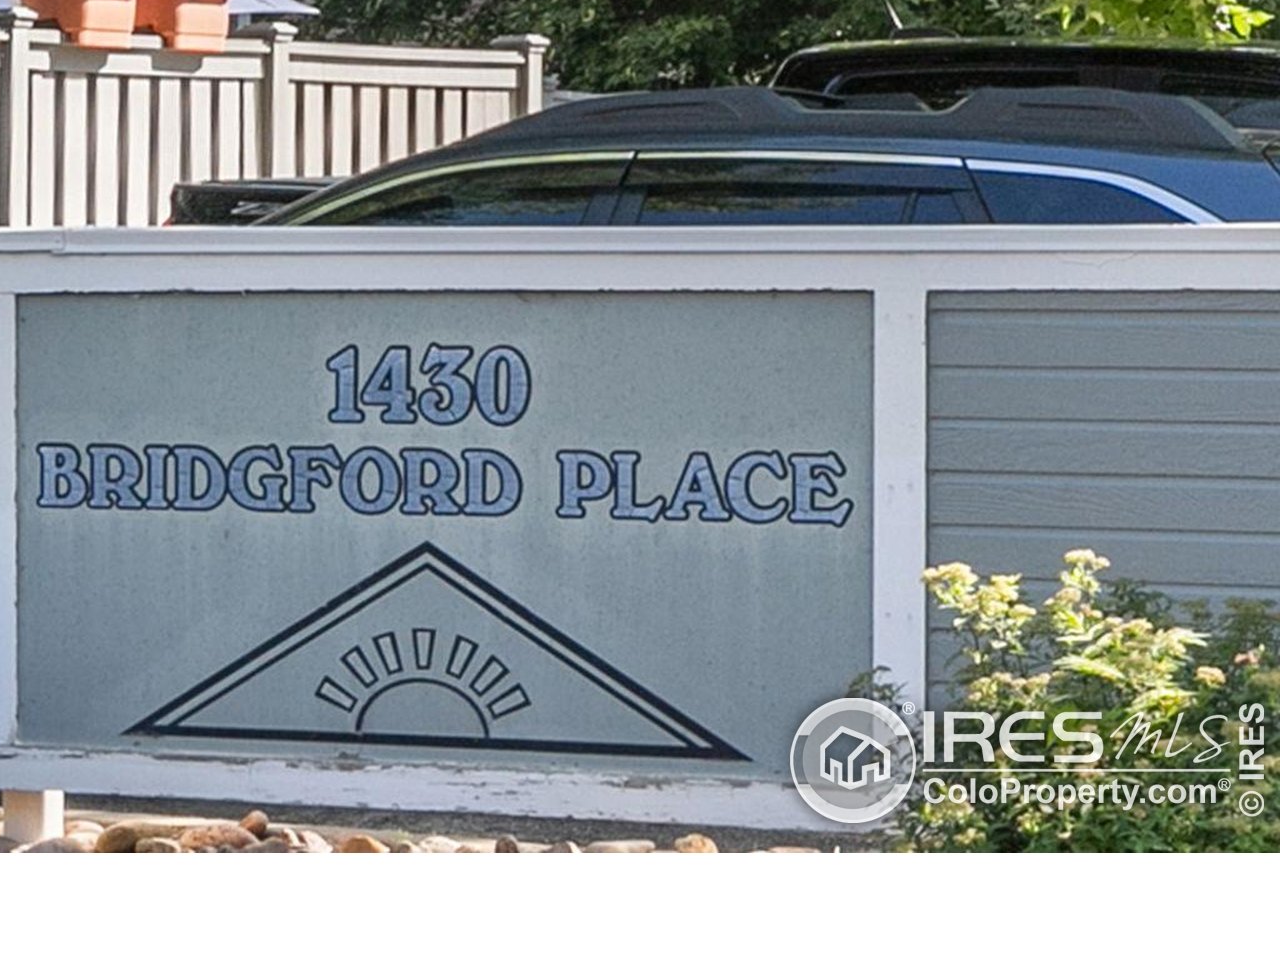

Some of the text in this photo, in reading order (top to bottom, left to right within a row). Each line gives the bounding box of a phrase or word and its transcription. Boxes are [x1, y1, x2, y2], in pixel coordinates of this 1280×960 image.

[326, 342, 532, 427] 1430
[36, 443, 854, 526] BRIDGFORD PLACE
